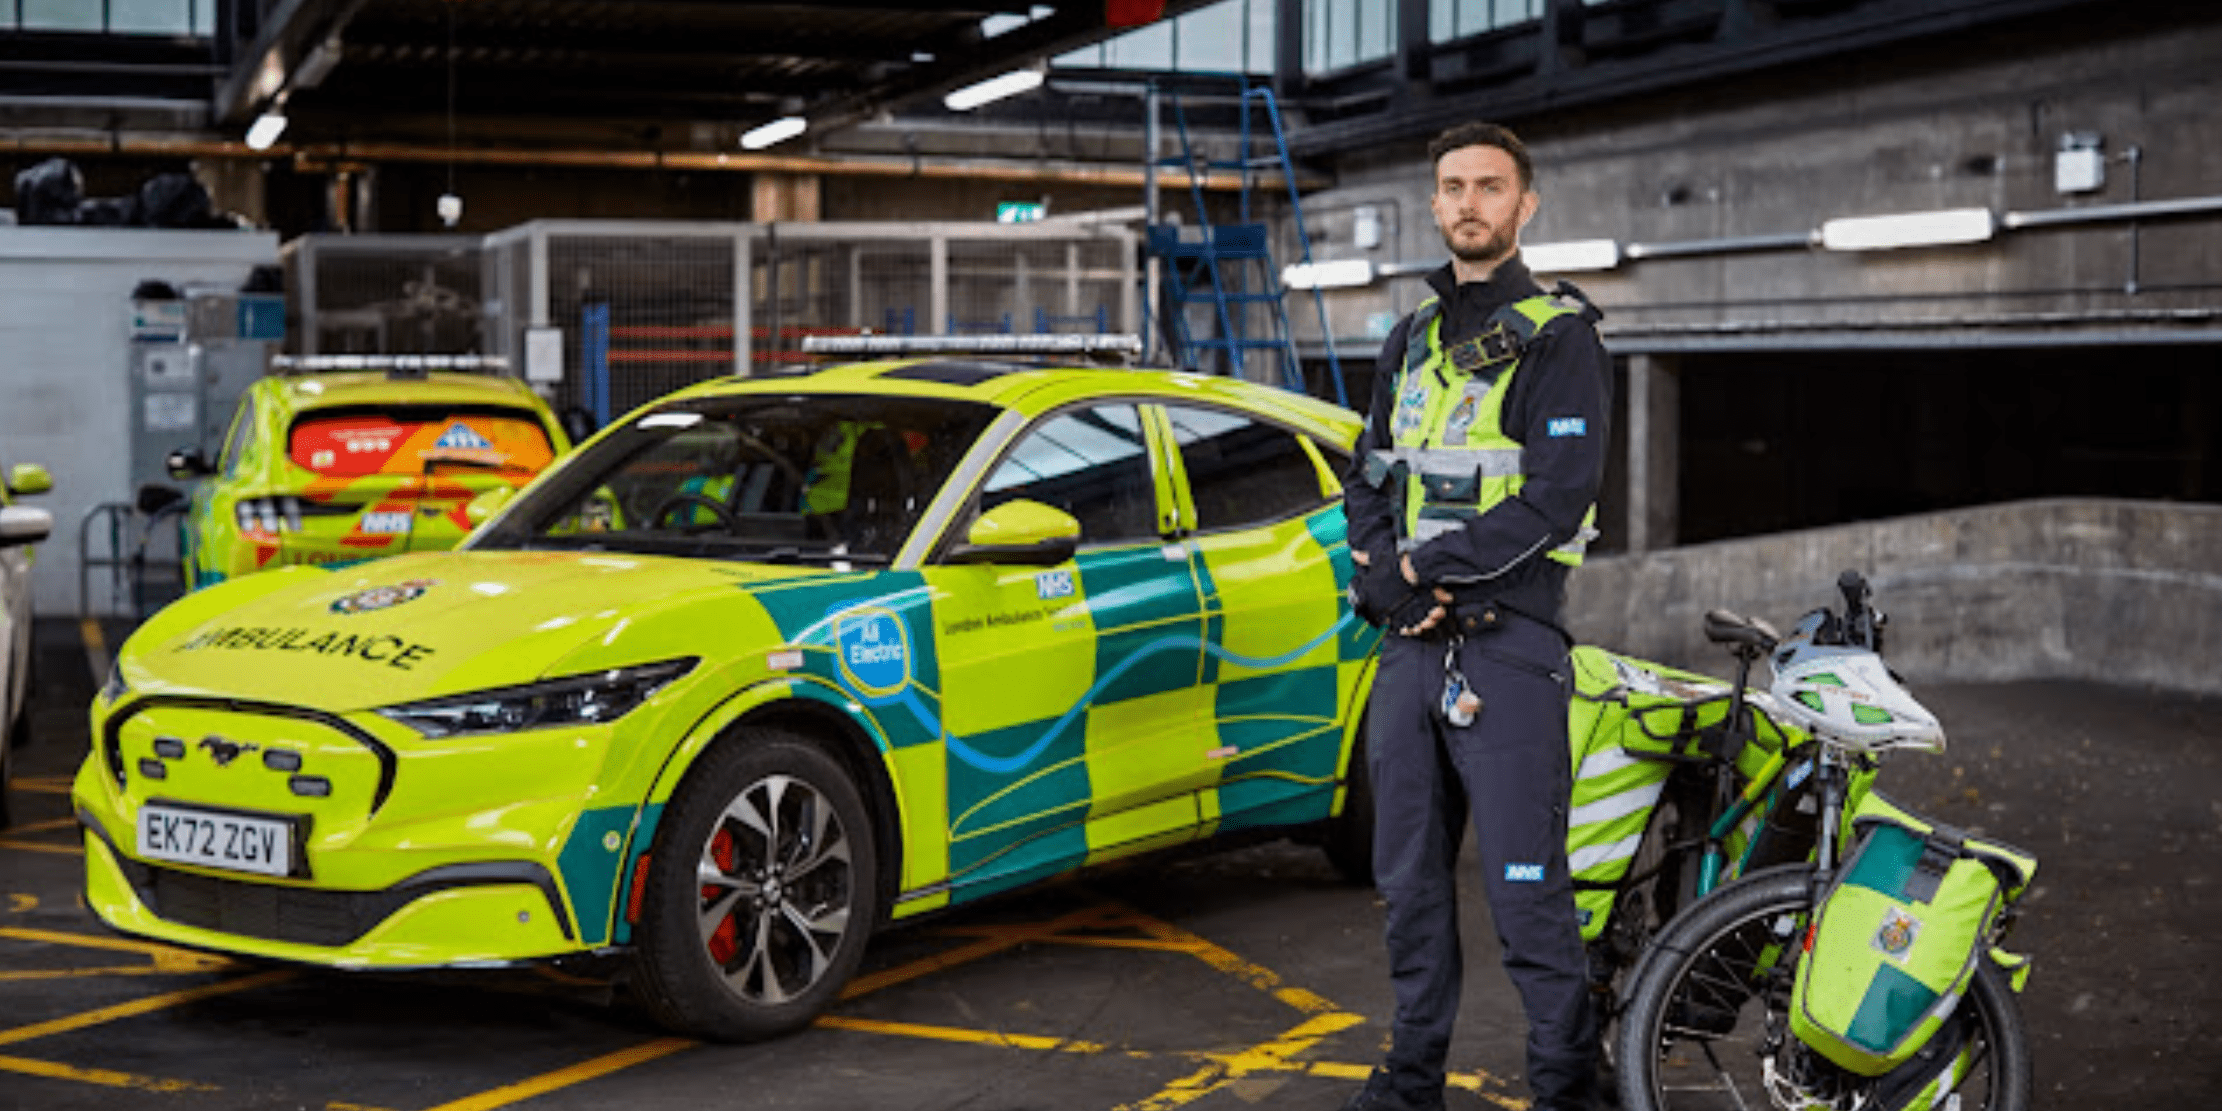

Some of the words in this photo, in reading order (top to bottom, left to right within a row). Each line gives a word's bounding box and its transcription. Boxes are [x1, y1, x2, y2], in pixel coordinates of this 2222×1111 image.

[1548, 419, 1584, 435] NHS
[363, 512, 411, 533] NHS
[1037, 572, 1073, 599] NHS
[943, 617, 984, 635] London
[986, 609, 1043, 628] Ambulance
[172, 626, 436, 671] AMBULANCE
[850, 638, 902, 664] Electric
[146, 813, 216, 857] EK72
[223, 822, 276, 864] ZGV
[1506, 864, 1542, 880] NHS
